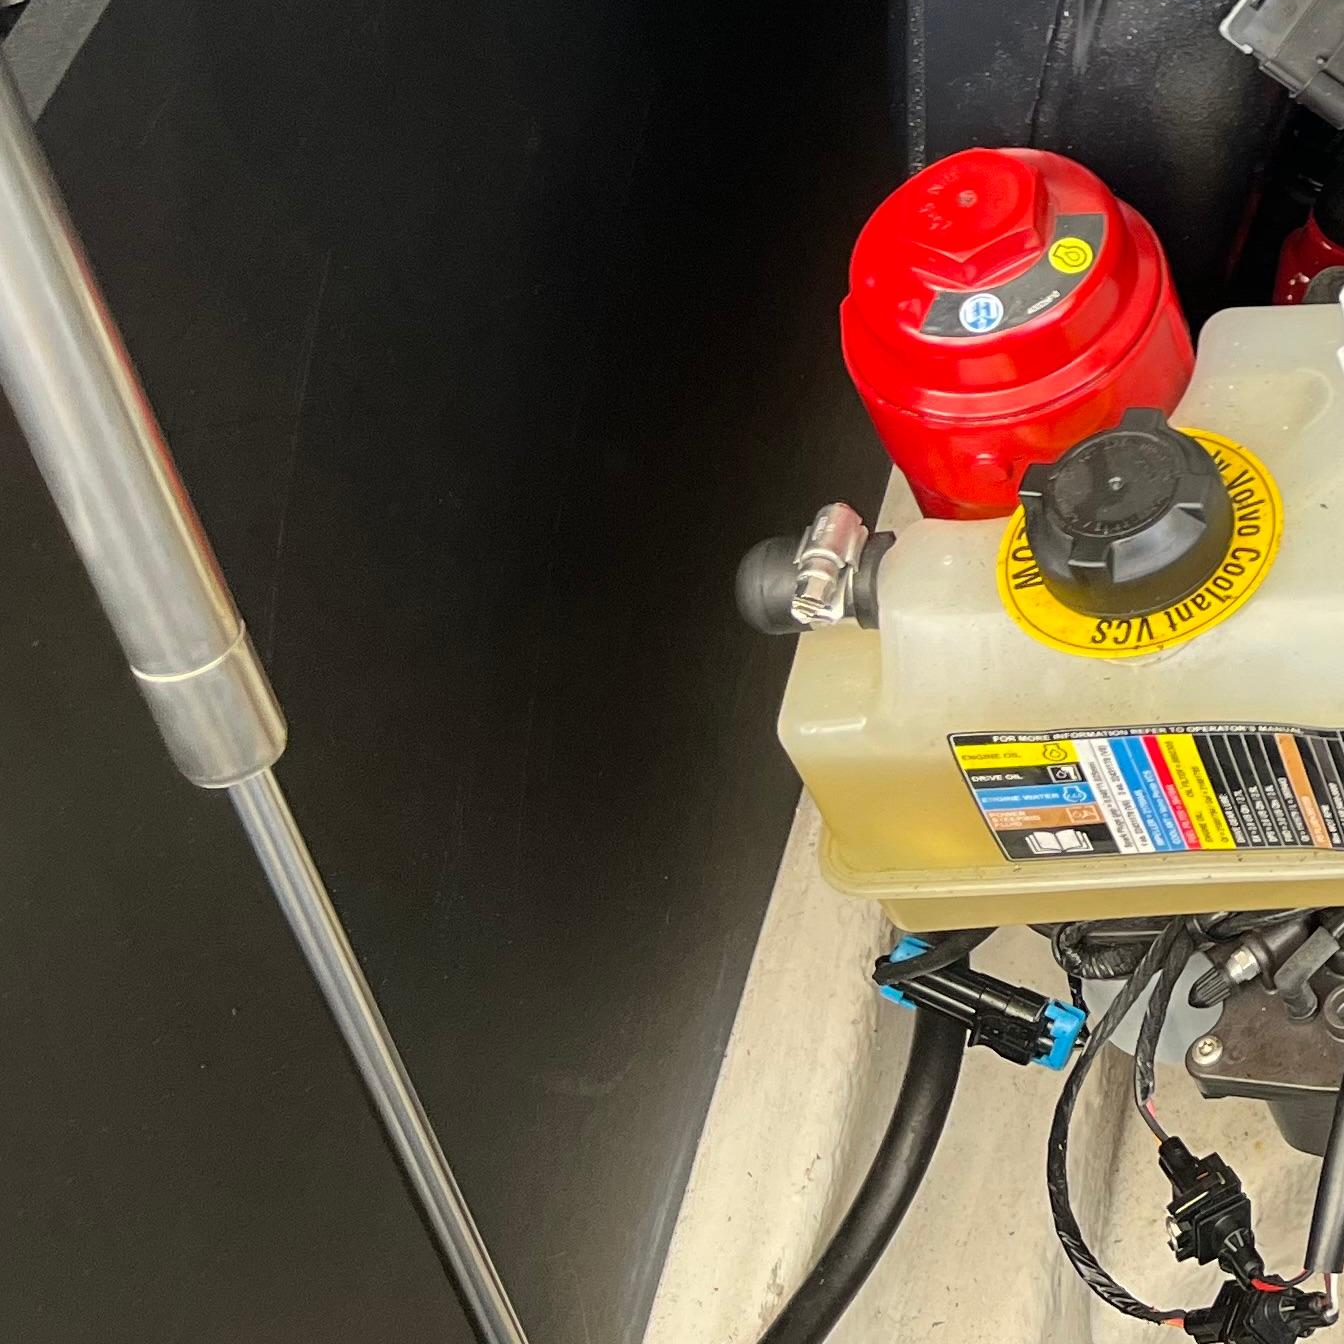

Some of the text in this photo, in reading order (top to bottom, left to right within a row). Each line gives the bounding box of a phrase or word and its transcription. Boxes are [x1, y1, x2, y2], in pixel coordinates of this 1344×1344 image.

[1091, 468, 1266, 645] Volvo Coolant VCS
[993, 735, 1017, 743] FOR
[1017, 734, 1051, 742] MORE
[1053, 729, 1128, 740] INFORMATION
[971, 773, 1024, 783] DRIVE OIL
